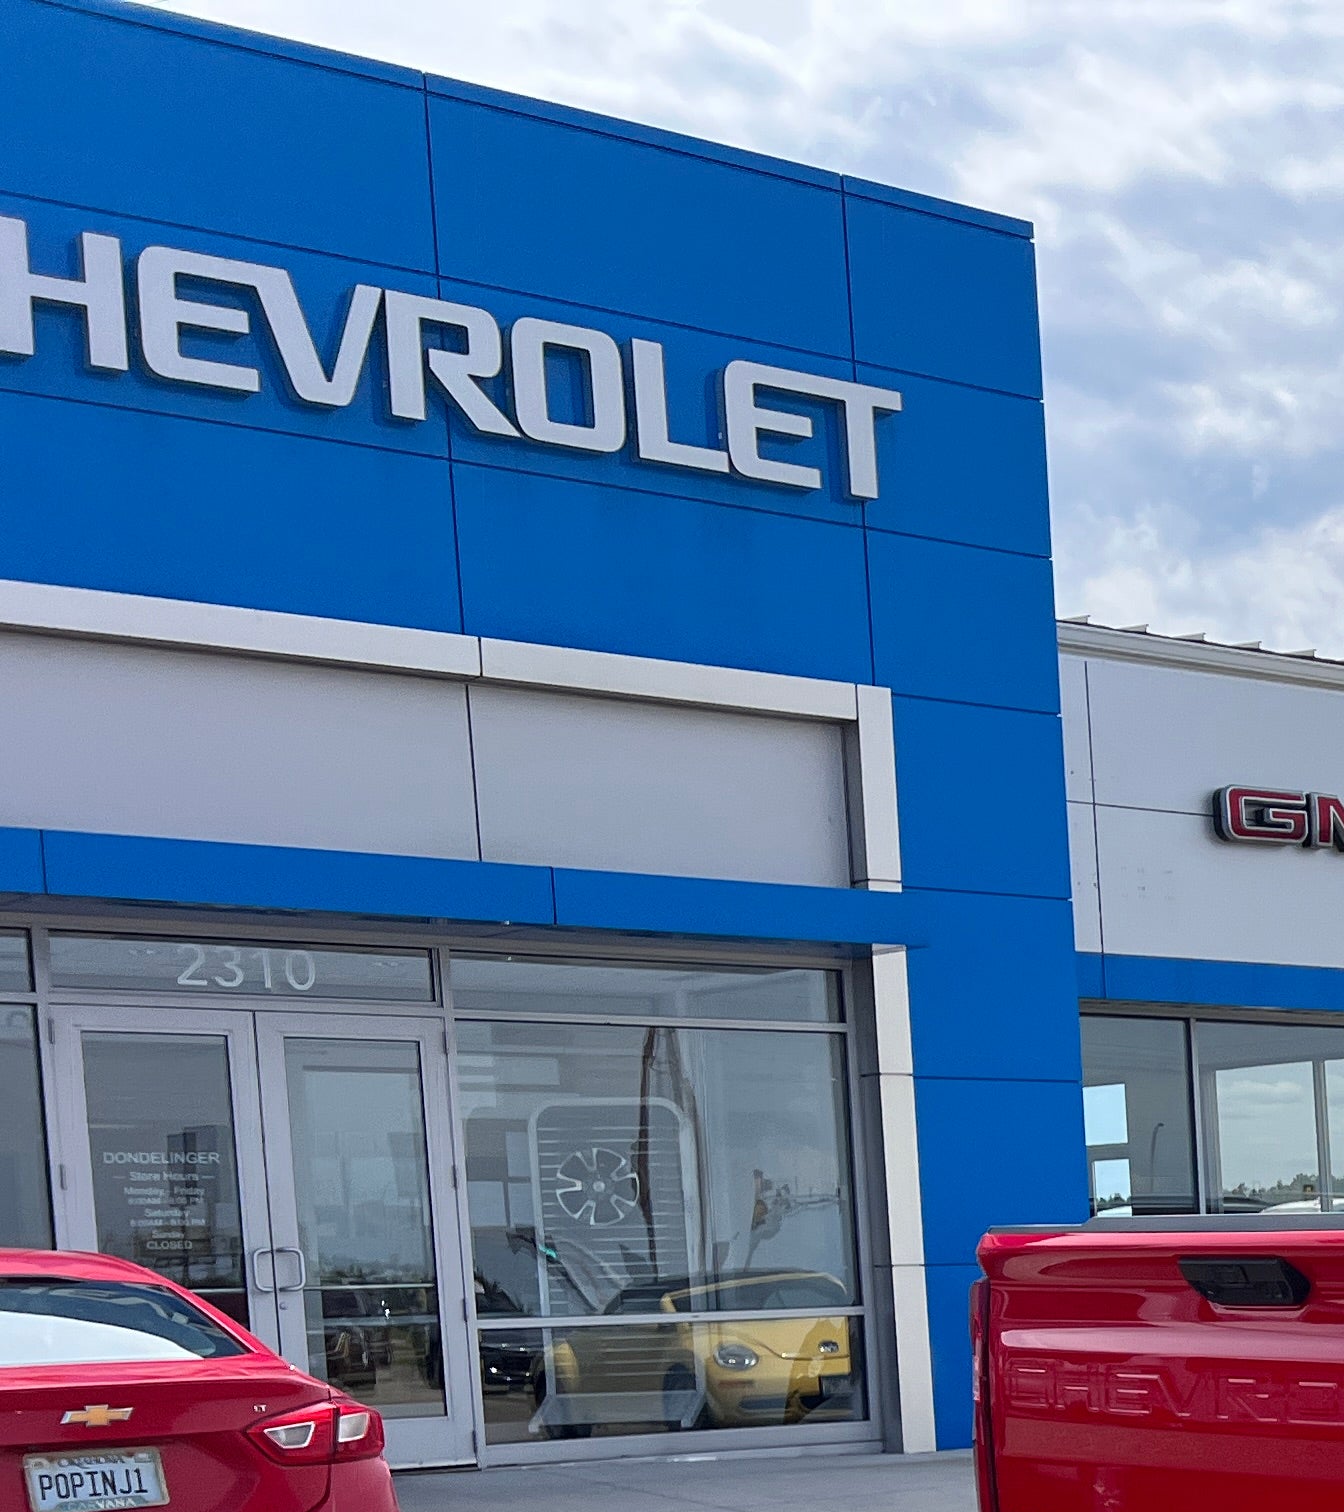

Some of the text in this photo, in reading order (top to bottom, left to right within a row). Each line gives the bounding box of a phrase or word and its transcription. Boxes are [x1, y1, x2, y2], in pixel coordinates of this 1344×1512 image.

[177, 944, 316, 991] 2310
[102, 1151, 220, 1165] DONDELINGER
[146, 1240, 193, 1250] CLOSED
[38, 1468, 149, 1501] POPINJ1
